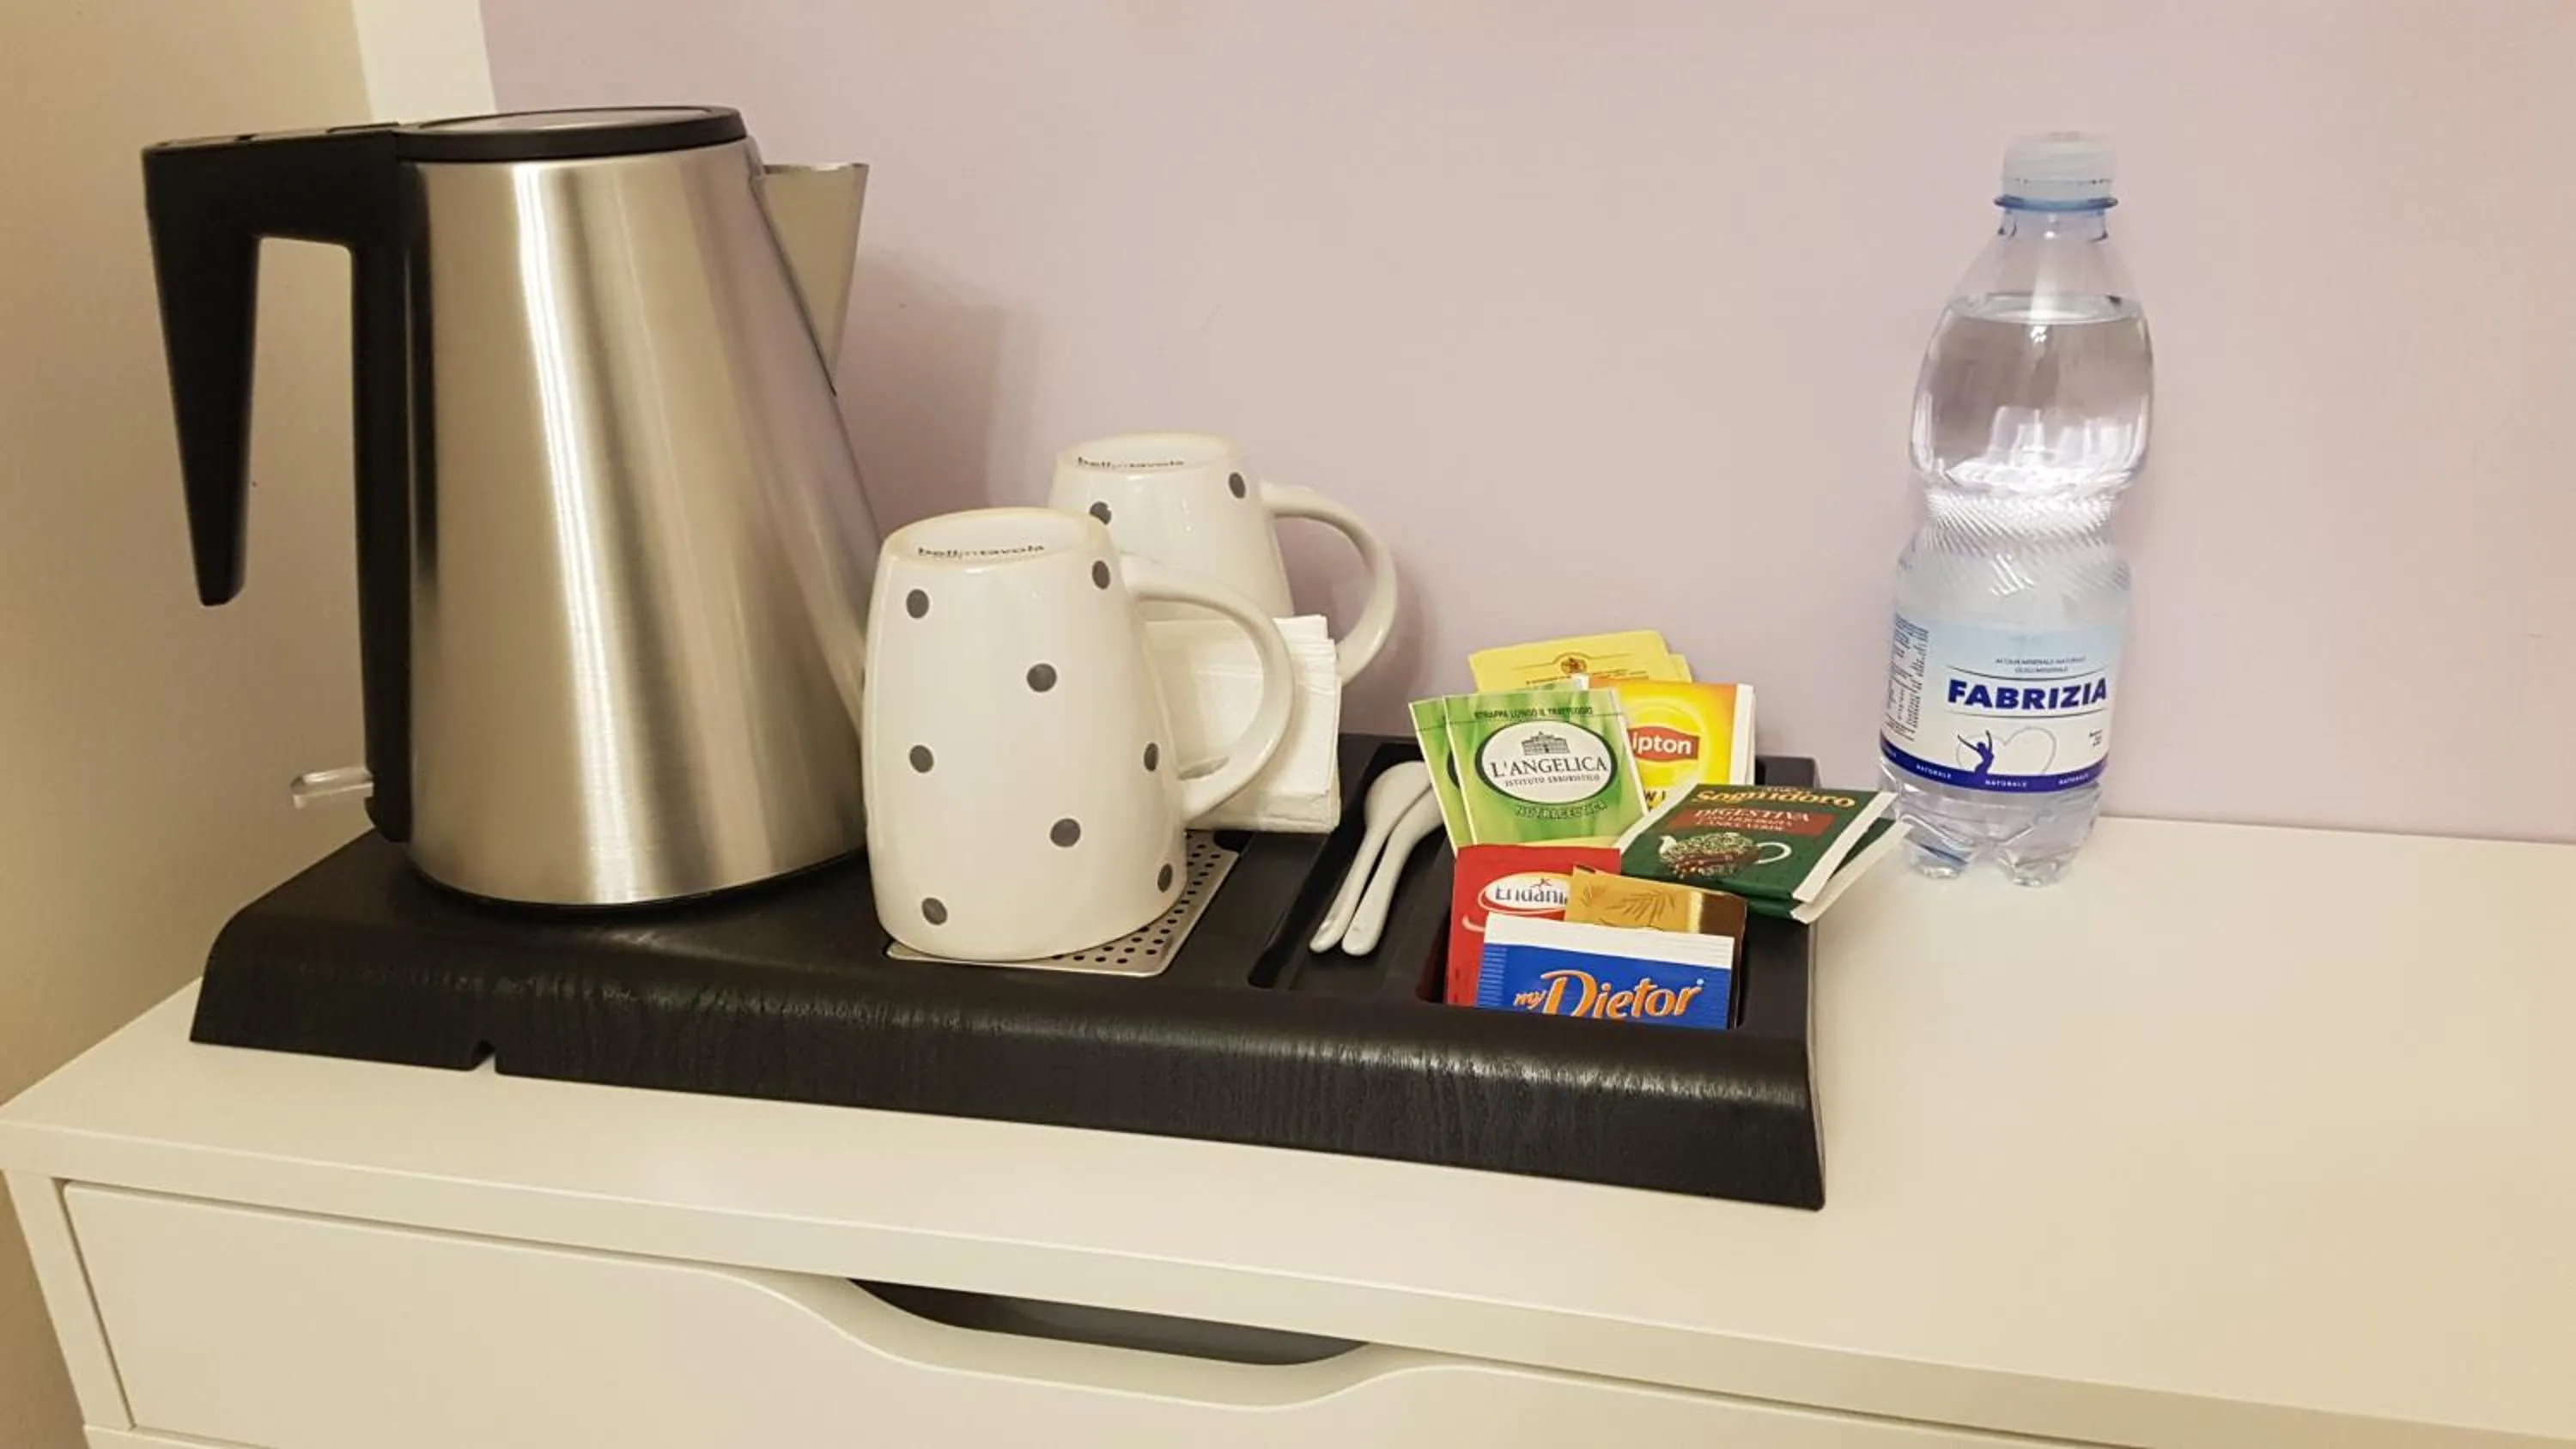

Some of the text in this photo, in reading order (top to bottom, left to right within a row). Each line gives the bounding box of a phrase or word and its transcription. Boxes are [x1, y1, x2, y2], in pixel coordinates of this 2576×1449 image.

[1947, 676, 2107, 710] FABRIZIA
[1632, 731, 1692, 755] ipton
[1490, 755, 1607, 779] L'ANGELICA
[1504, 777, 1545, 787] ISTITUTO
[1984, 778, 2028, 788] NATURALE
[1694, 808, 1810, 822] DIGESTIVA
[1495, 883, 1568, 905] Eridani
[1513, 969, 1704, 1019] my Dietor
